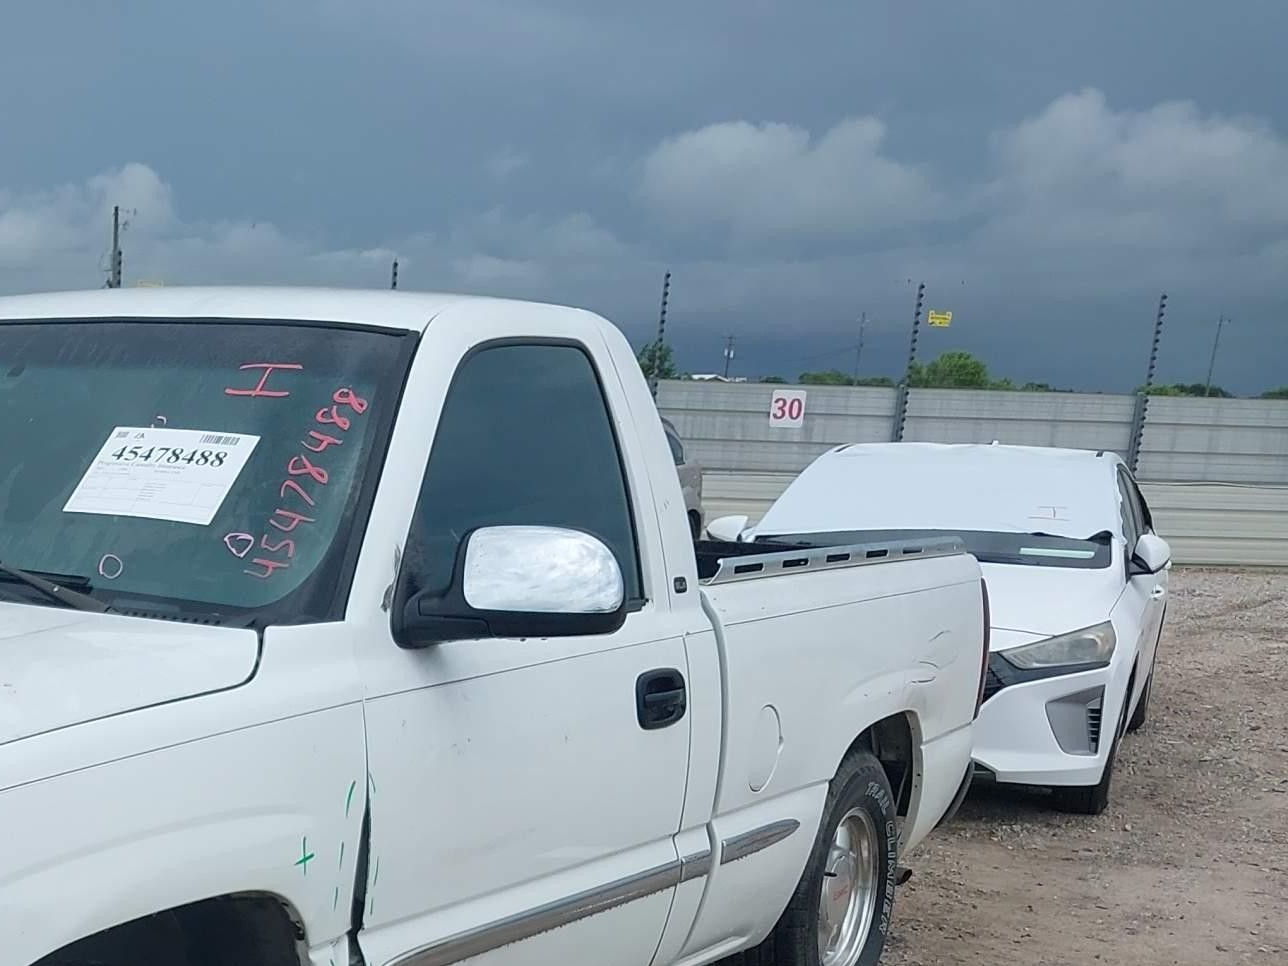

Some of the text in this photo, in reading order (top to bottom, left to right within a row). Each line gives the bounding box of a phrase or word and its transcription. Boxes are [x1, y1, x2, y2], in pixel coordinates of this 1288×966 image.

[772, 397, 803, 420] 30
[112, 444, 228, 468] 45478488
[243, 386, 369, 579] 45478488
[865, 781, 897, 936] TRAIL CLIMBER
